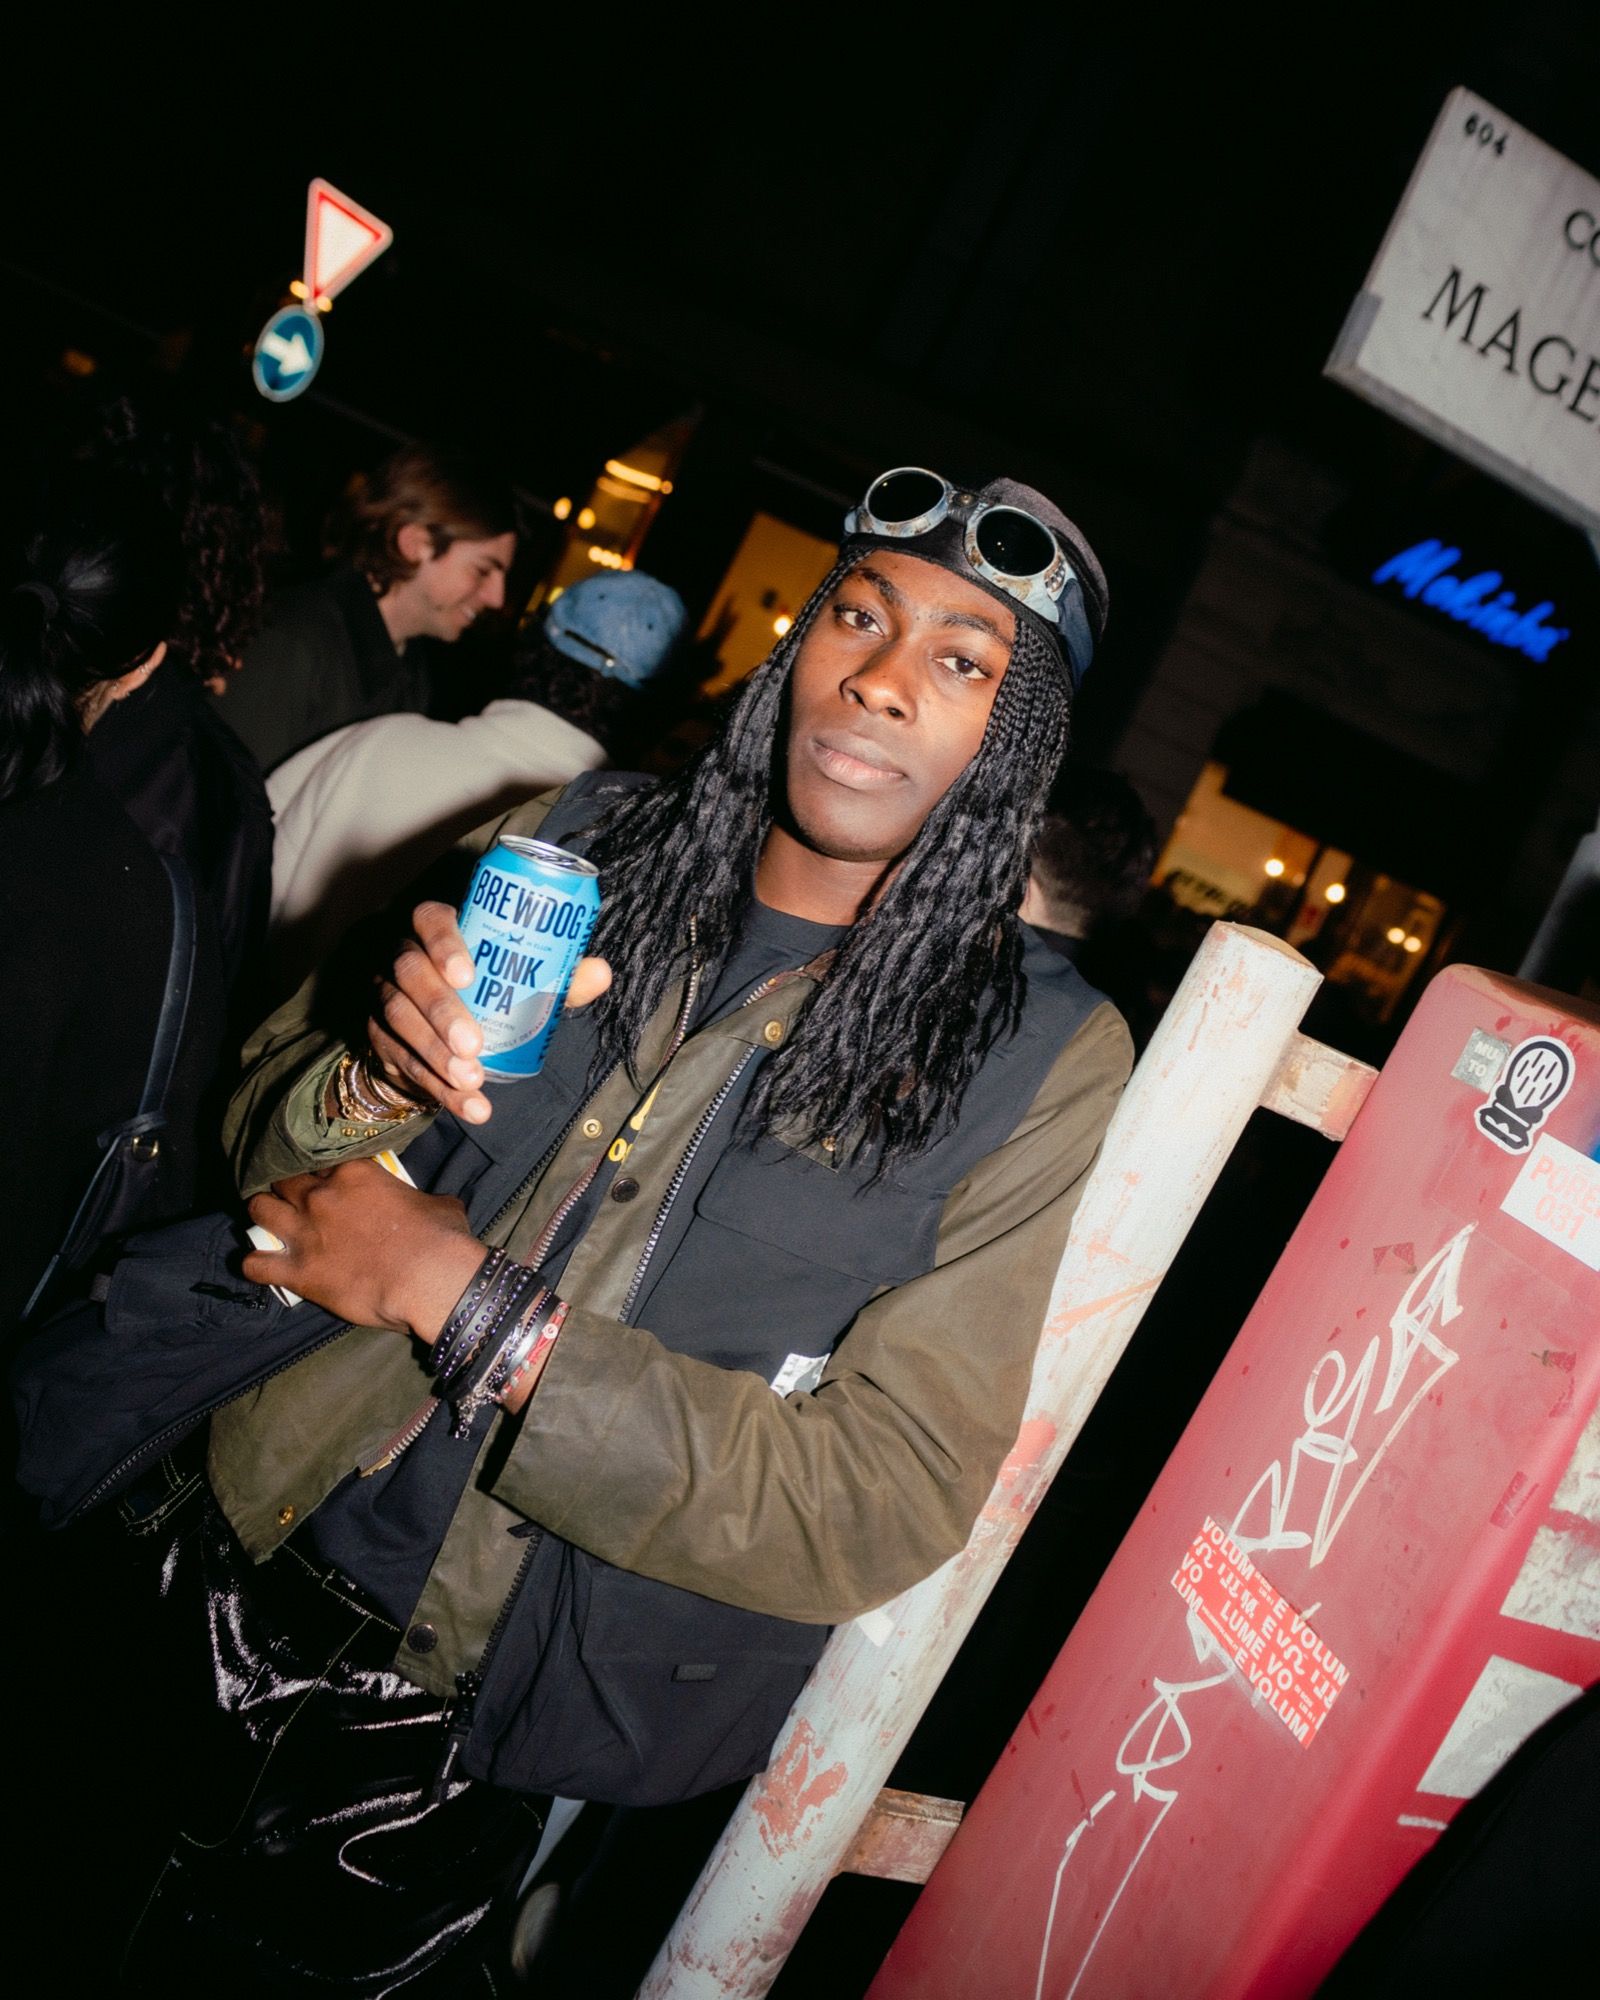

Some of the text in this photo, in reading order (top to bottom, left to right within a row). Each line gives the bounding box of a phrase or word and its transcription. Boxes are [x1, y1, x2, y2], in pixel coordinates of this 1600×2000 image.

[1464, 112, 1510, 156] 604
[473, 869, 586, 939] BREWDOG
[475, 938, 544, 988] PUNK
[474, 976, 514, 1015] IPA
[1468, 1059, 1488, 1077] TO
[1202, 1515, 1256, 1581] VOLUM
[1181, 1552, 1203, 1584] VO
[1219, 1600, 1267, 1660] LUME
[1266, 1653, 1293, 1691] VO
[1249, 1662, 1310, 1743] VOLUM
